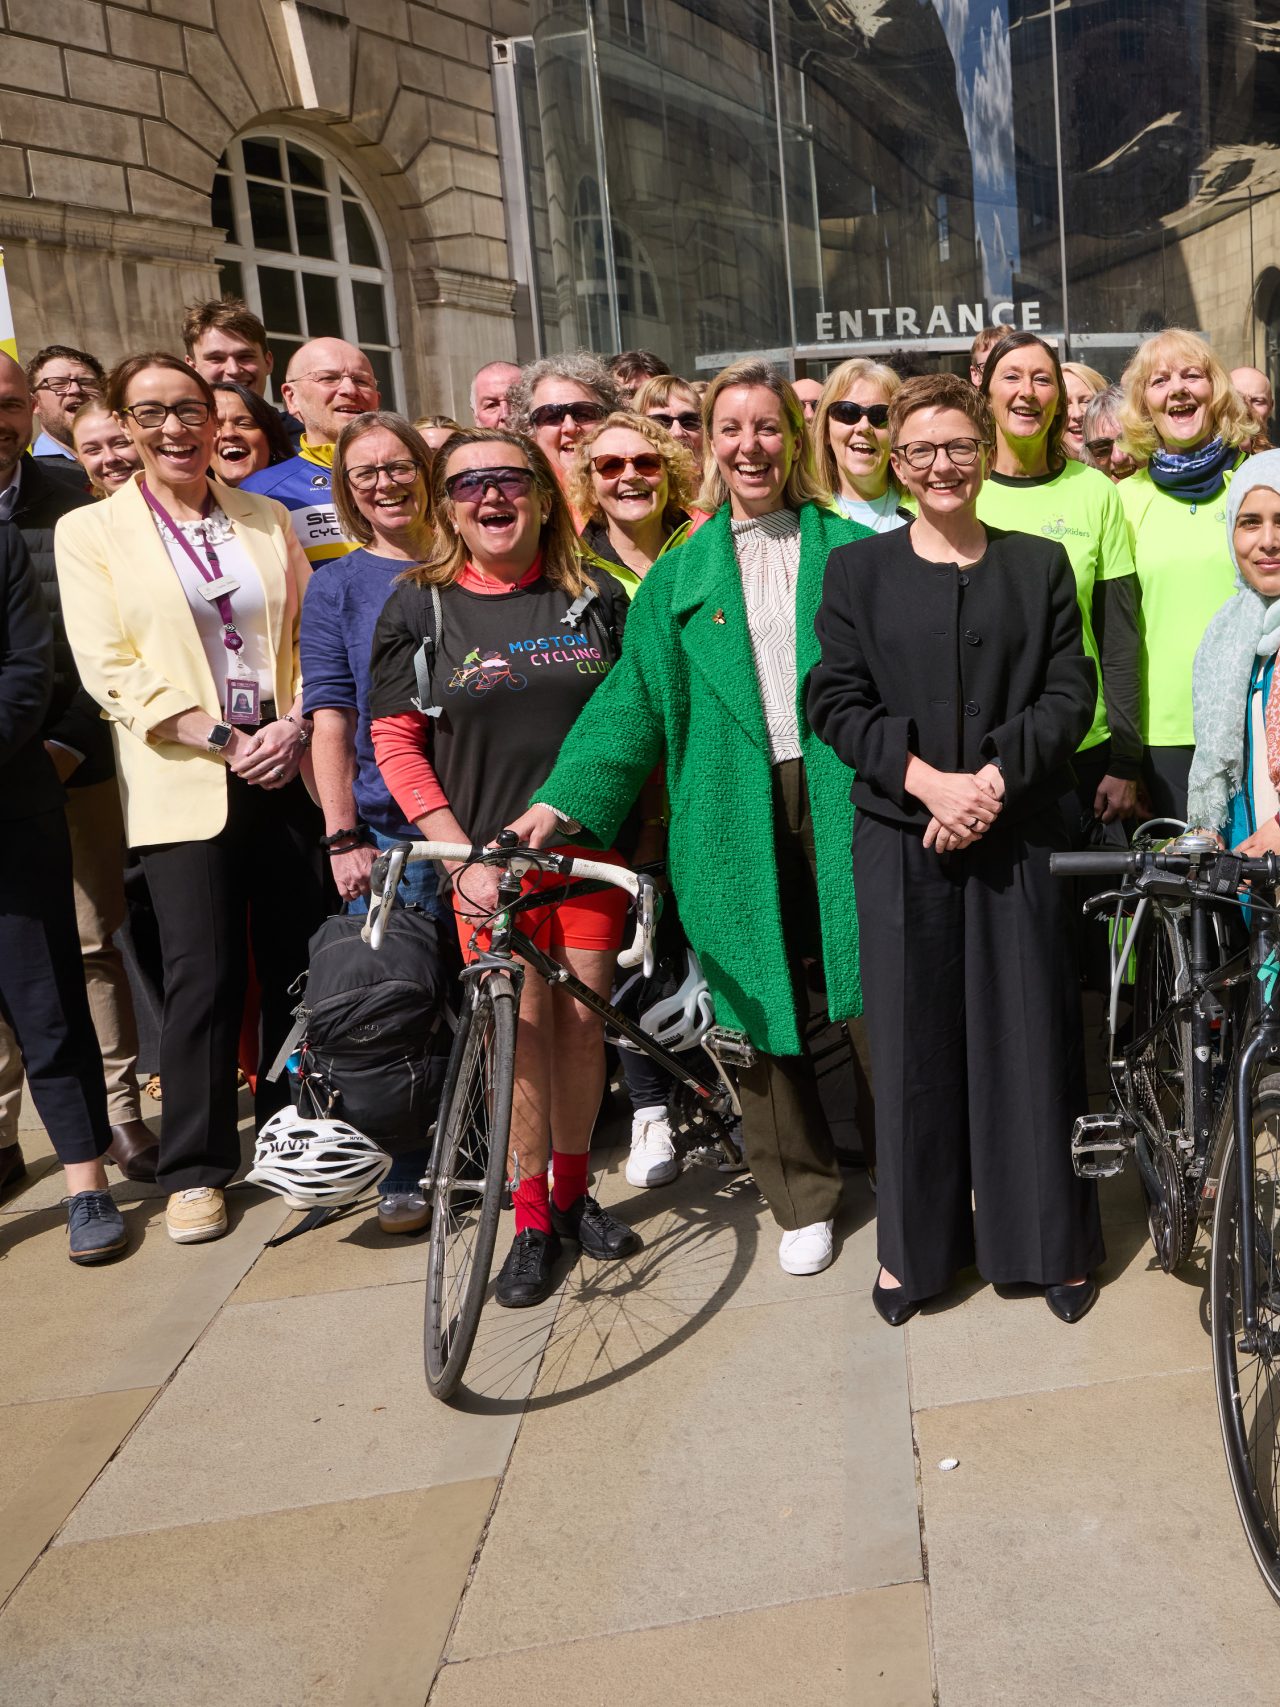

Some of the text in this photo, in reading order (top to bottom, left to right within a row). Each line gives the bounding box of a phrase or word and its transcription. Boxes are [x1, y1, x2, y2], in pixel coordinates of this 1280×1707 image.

[815, 301, 1042, 341] ENTRANCE
[306, 512, 337, 526] SE
[309, 527, 342, 539] CYC
[508, 632, 588, 654] MOSTON
[530, 647, 601, 666] CYCLING
[576, 660, 612, 675] CLUB
[269, 1138, 310, 1153] KASK
